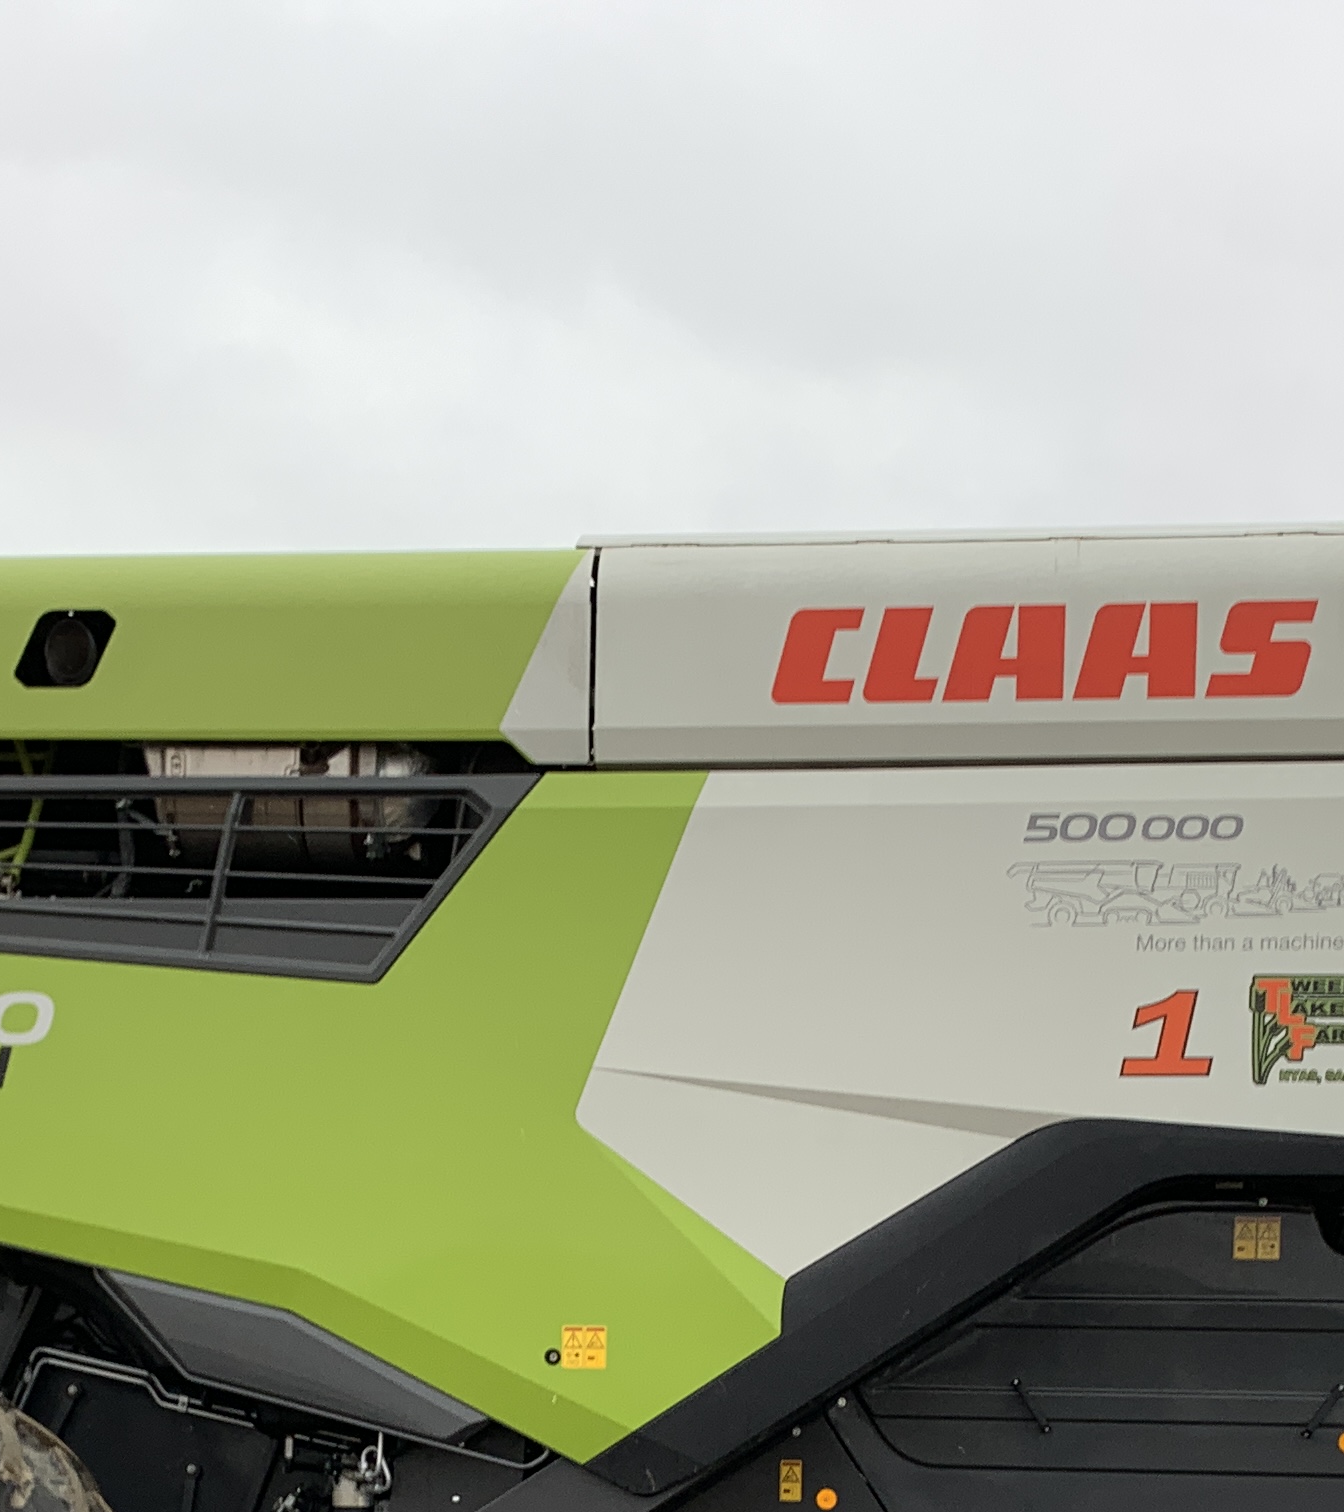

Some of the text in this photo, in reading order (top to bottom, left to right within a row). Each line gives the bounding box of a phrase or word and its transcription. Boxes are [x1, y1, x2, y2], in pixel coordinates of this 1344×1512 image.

[770, 599, 1319, 705] CLAAS
[1023, 811, 1137, 842] 500
[1135, 932, 1344, 952] More than a machine
[1119, 988, 1214, 1078] 1
